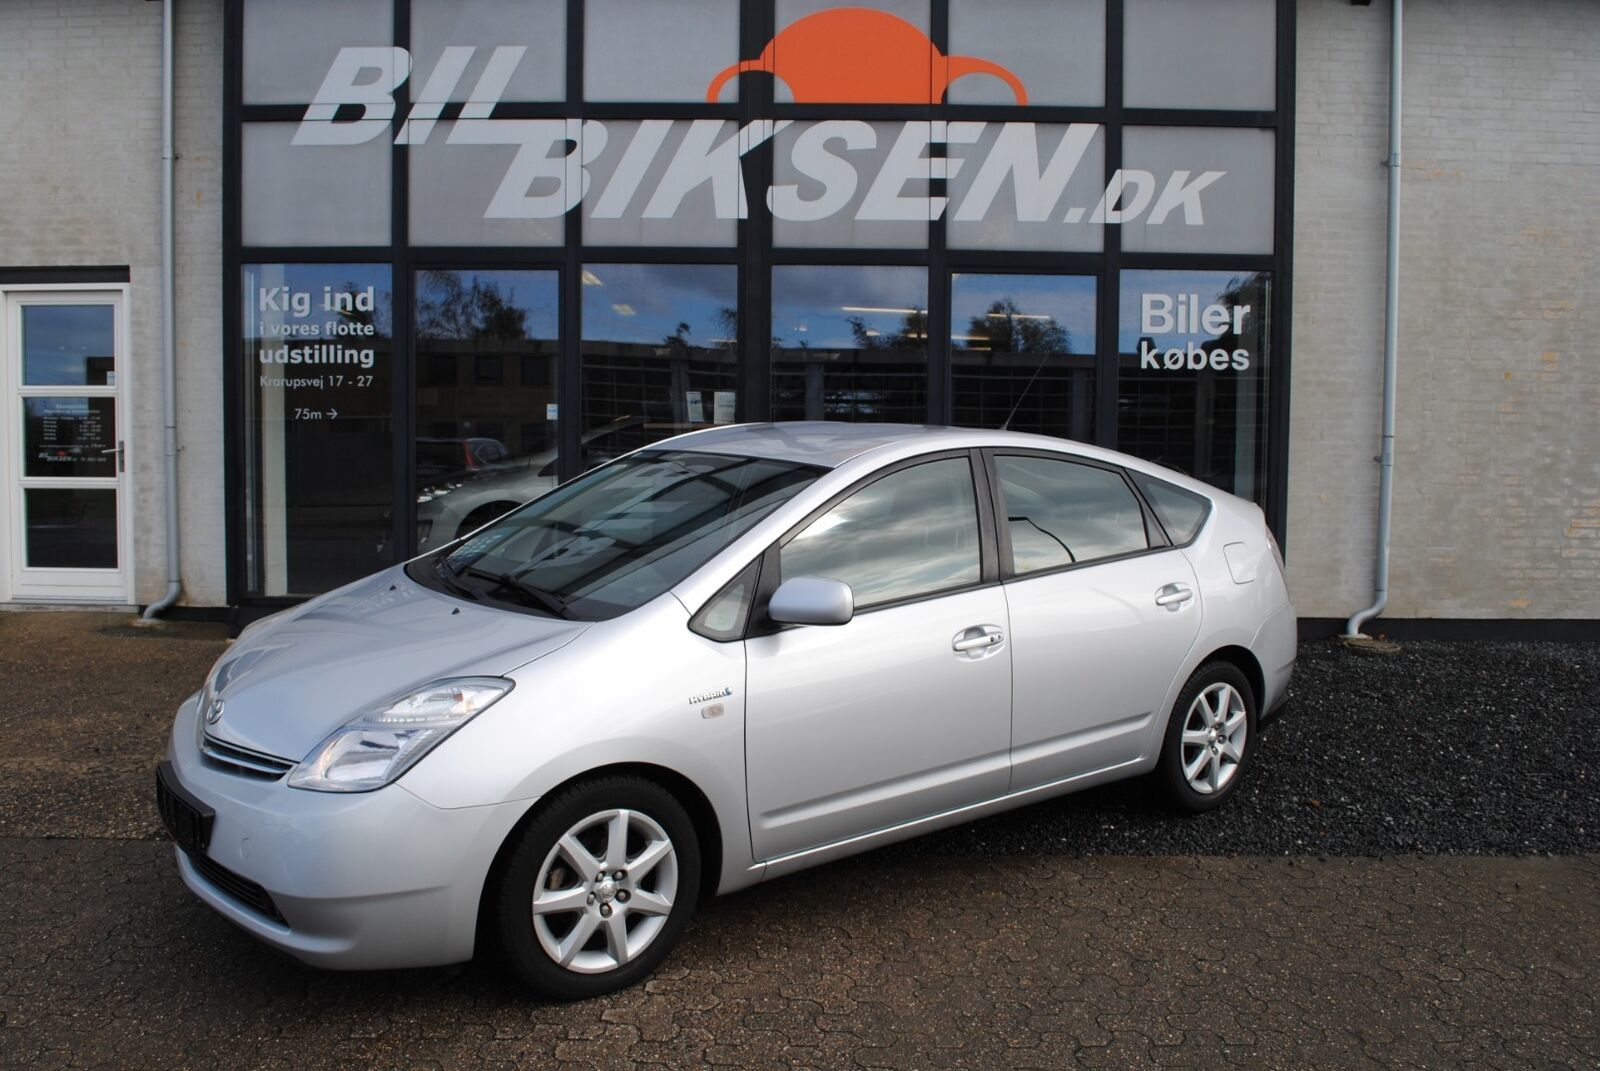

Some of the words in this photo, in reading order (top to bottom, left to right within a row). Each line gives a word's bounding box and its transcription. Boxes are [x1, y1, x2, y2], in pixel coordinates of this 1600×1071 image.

[290, 46, 527, 145] BIL
[482, 119, 1226, 225] BIKSEN.DK
[259, 286, 311, 317] Kig
[324, 286, 374, 311] ind
[1142, 293, 1250, 335] Biler
[260, 322, 264, 335] i
[271, 324, 319, 335] vores
[325, 322, 374, 335] flotte
[260, 345, 374, 368] udstilling
[1141, 341, 1250, 370] købes
[260, 376, 323, 389] Krarupsvej
[328, 376, 343, 387] 17
[357, 376, 373, 387] 27
[295, 408, 322, 419] 75m
